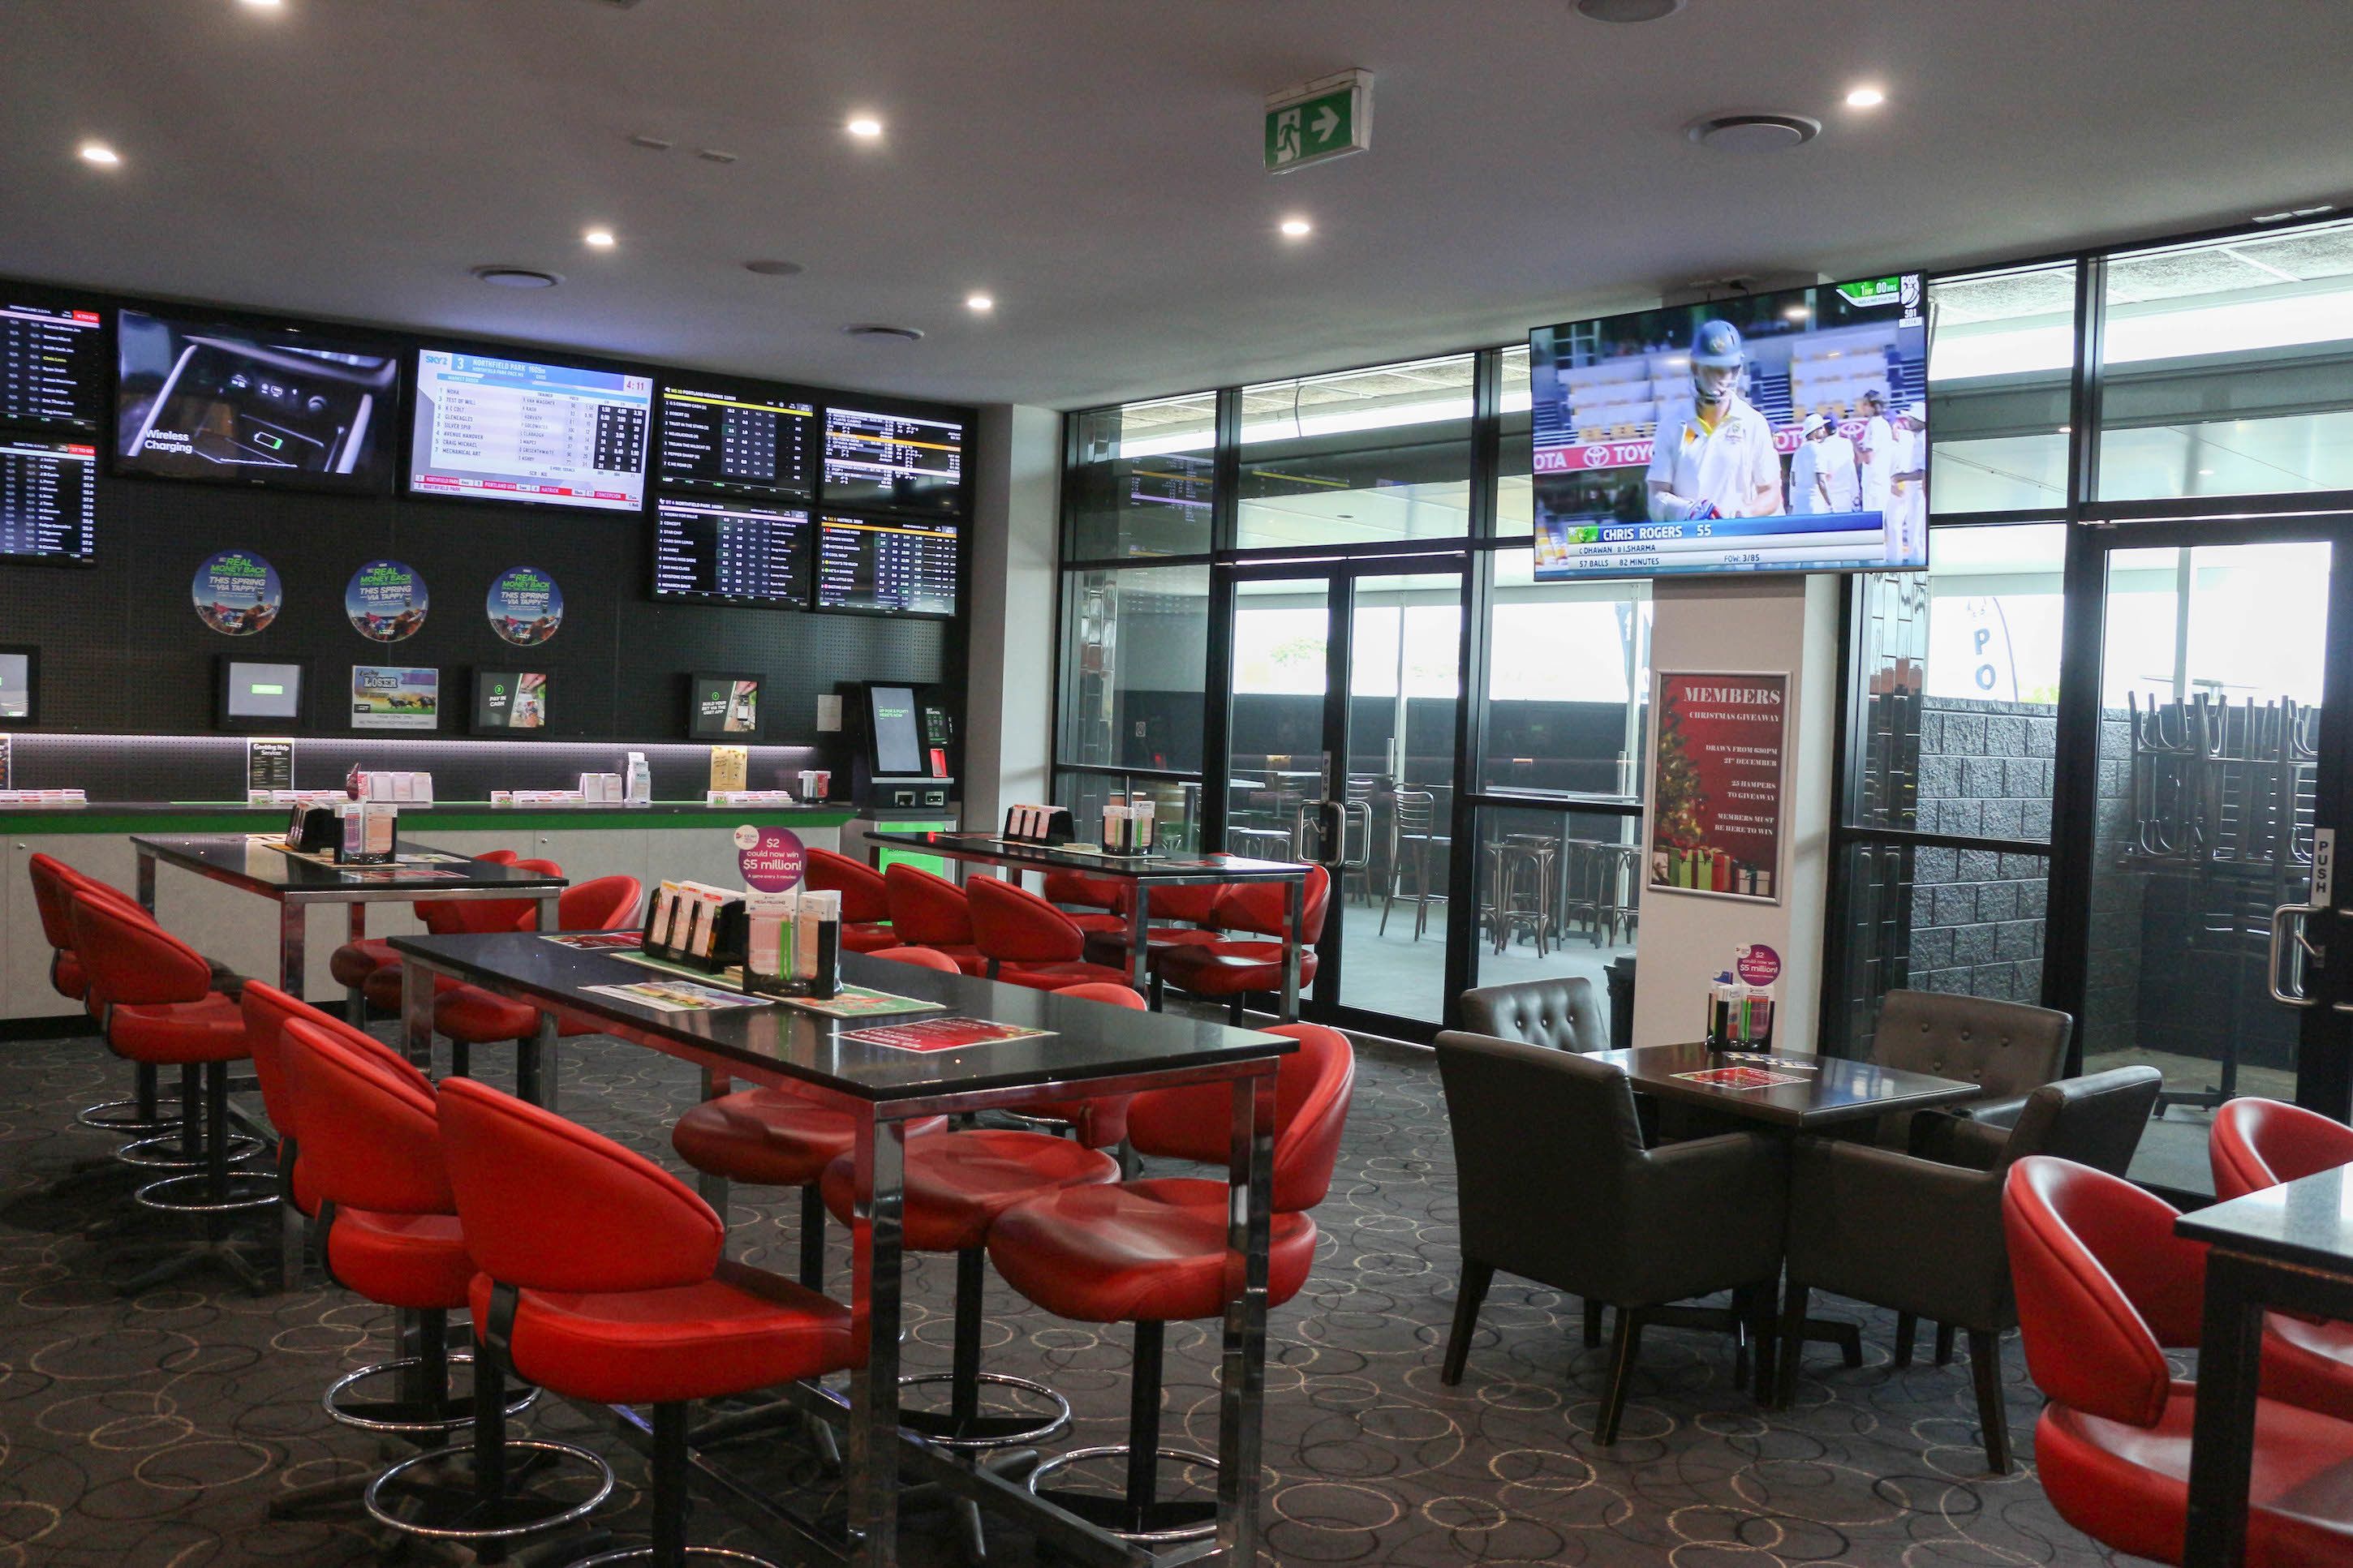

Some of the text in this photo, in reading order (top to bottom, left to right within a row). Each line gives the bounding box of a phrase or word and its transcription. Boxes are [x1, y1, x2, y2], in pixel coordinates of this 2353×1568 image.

[1904, 309, 1916, 318] 501
[457, 358, 464, 369] 3
[473, 359, 509, 369] NORTHFIELD
[510, 363, 526, 372] PARK
[627, 381, 644, 390] 4:11
[146, 430, 189, 441] Wireless
[144, 440, 193, 454] Charging
[1603, 525, 1711, 541] CHRIS ROGERS 55
[226, 557, 252, 566] REAL
[210, 565, 243, 573] MONEY
[231, 578, 265, 586] SPRING
[391, 574, 411, 582] BACK
[364, 677, 398, 688] LOSER
[1684, 687, 1780, 704] MEMBERS
[1689, 711, 1779, 722] CHRISTMAS GIVEAWAY
[1706, 745, 1732, 753] DRAWN
[1738, 793, 1774, 801] GIVEAWAY
[767, 838, 780, 848] $2
[743, 859, 802, 870] $5 million!
[2316, 841, 2328, 892] PUSH
